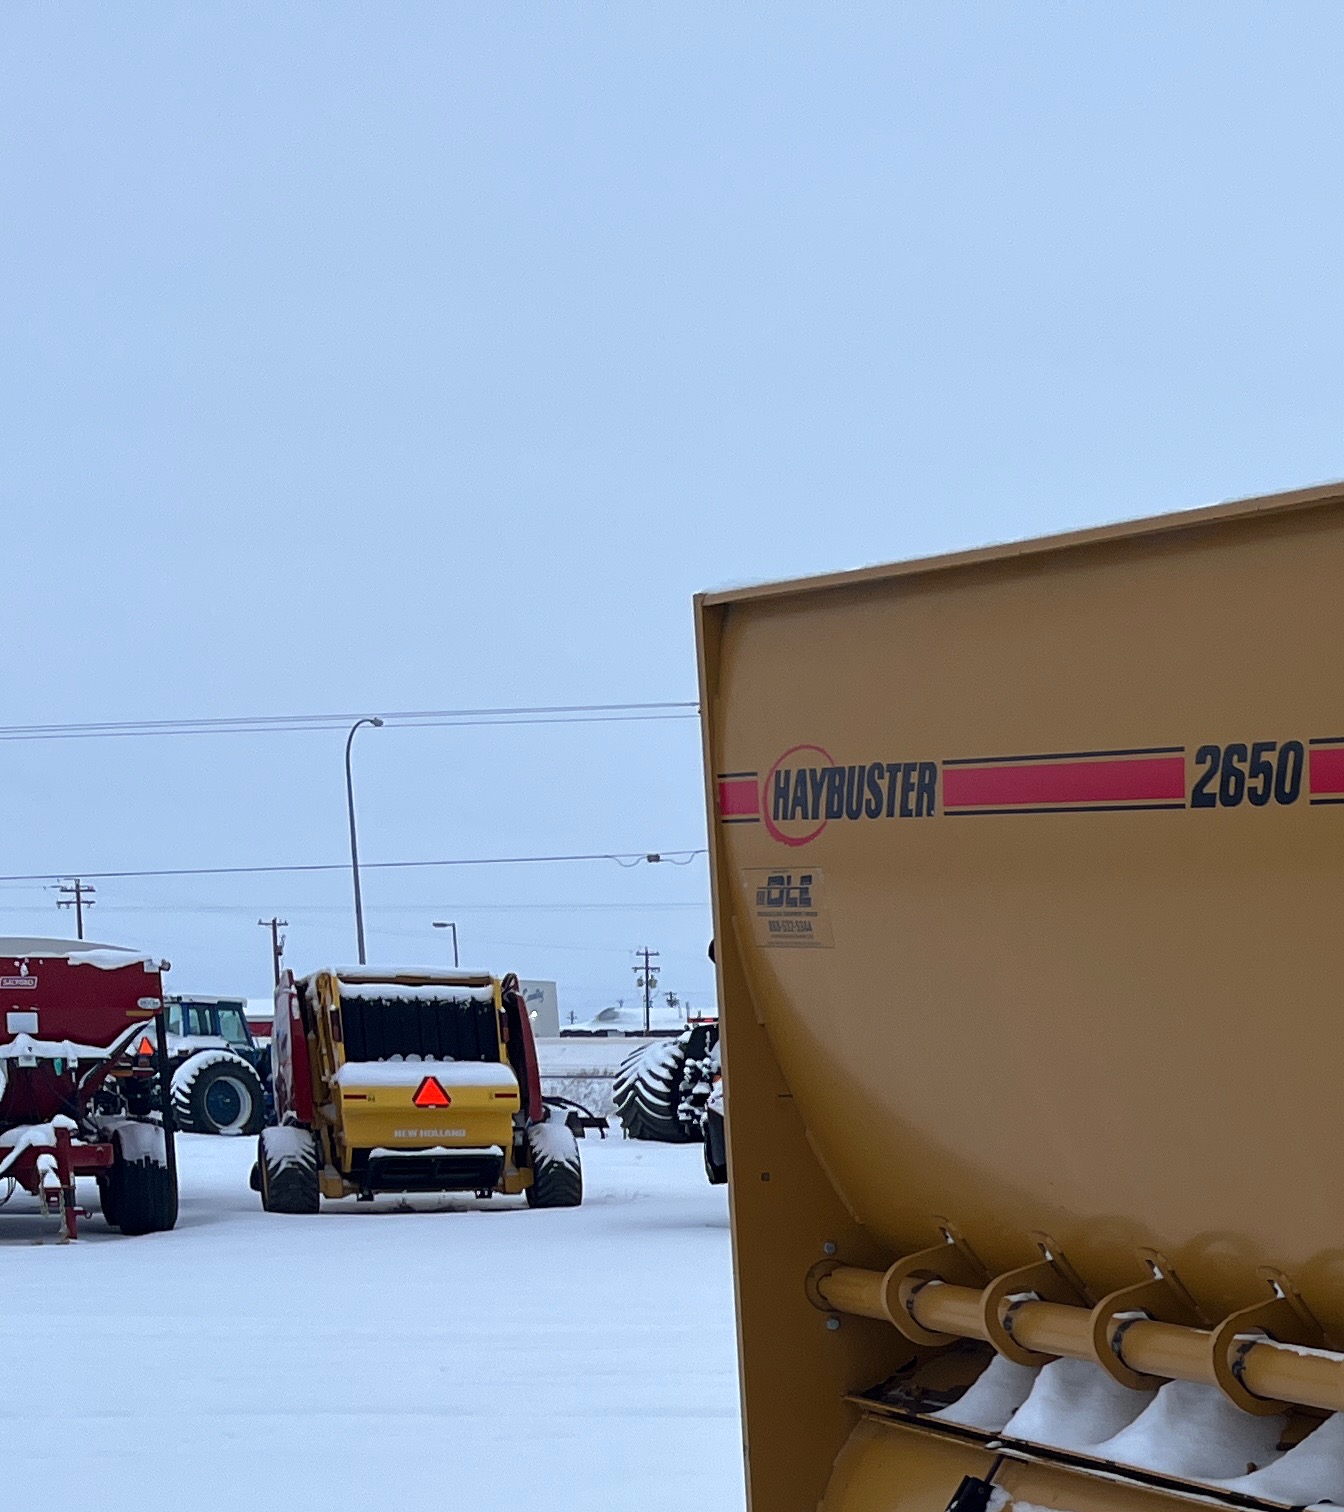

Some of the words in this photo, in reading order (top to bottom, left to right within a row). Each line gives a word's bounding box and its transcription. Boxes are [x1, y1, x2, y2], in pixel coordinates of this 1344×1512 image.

[773, 762, 937, 820] HAYBUSTER
[1191, 741, 1304, 808] 2650
[394, 1129, 418, 1138] NEW
